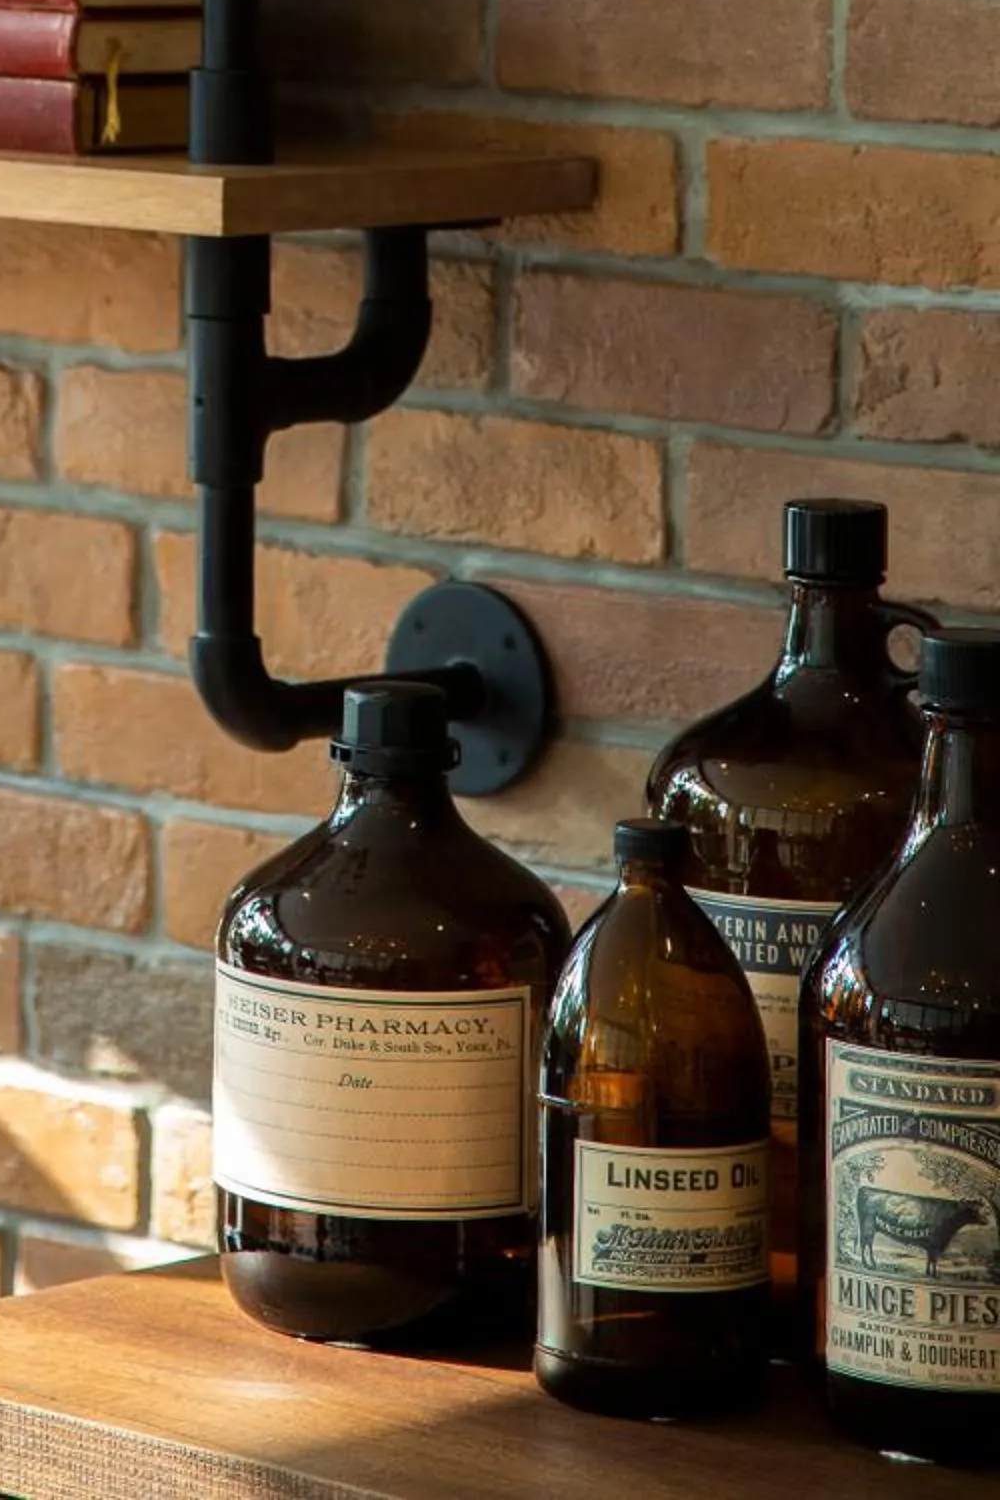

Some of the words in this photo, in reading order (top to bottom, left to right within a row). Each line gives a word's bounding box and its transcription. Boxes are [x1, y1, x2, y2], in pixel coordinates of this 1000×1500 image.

[777, 921, 819, 946] AND
[338, 1072, 373, 1090] Date
[854, 1076, 985, 1104] STANDARD
[607, 1161, 719, 1191] LINSEED
[838, 1275, 915, 1318] MINCE
[929, 1291, 1000, 1326] PIES
[831, 1324, 895, 1359] CHAMPLIN
[900, 1341, 913, 1363] &
